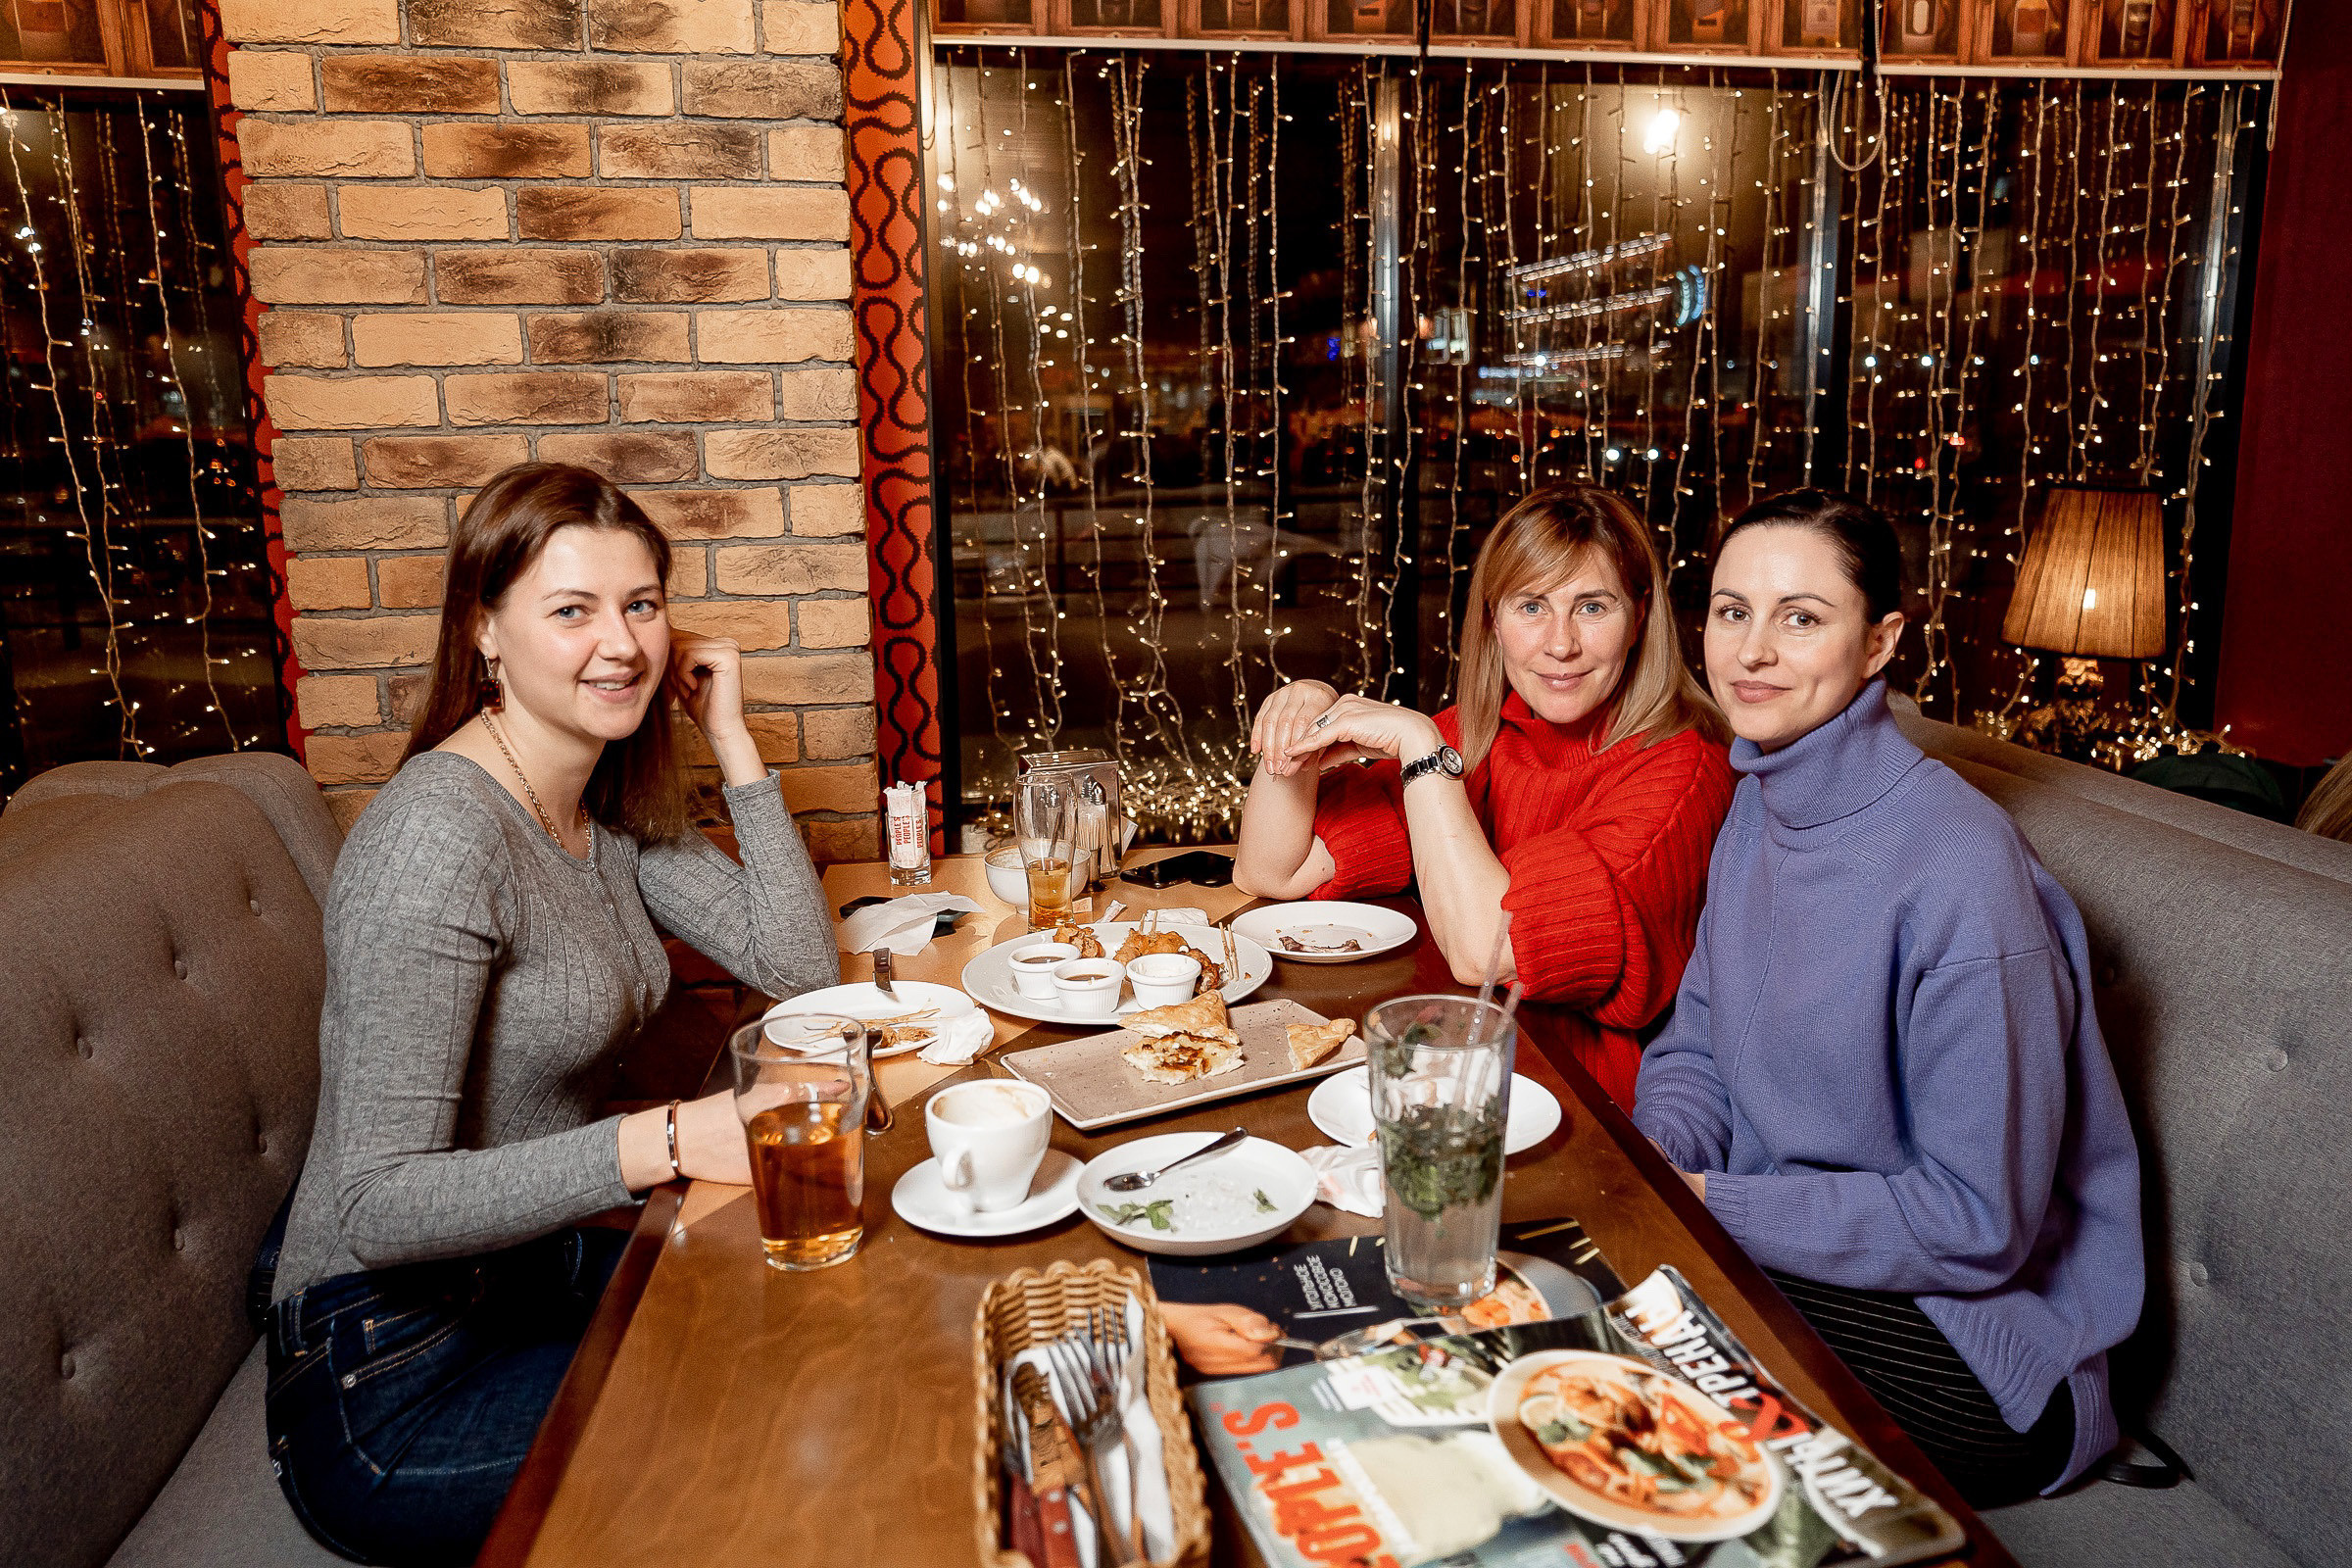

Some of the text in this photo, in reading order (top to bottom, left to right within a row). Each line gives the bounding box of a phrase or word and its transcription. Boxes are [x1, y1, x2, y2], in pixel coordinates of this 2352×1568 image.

[902, 814, 911, 845] PEOPLE'S
[915, 818, 924, 849] PEOPLE'S
[1625, 1284, 1762, 1408] ТРЕНДЫ
[1767, 1431, 1899, 1517] ХИТЫ
